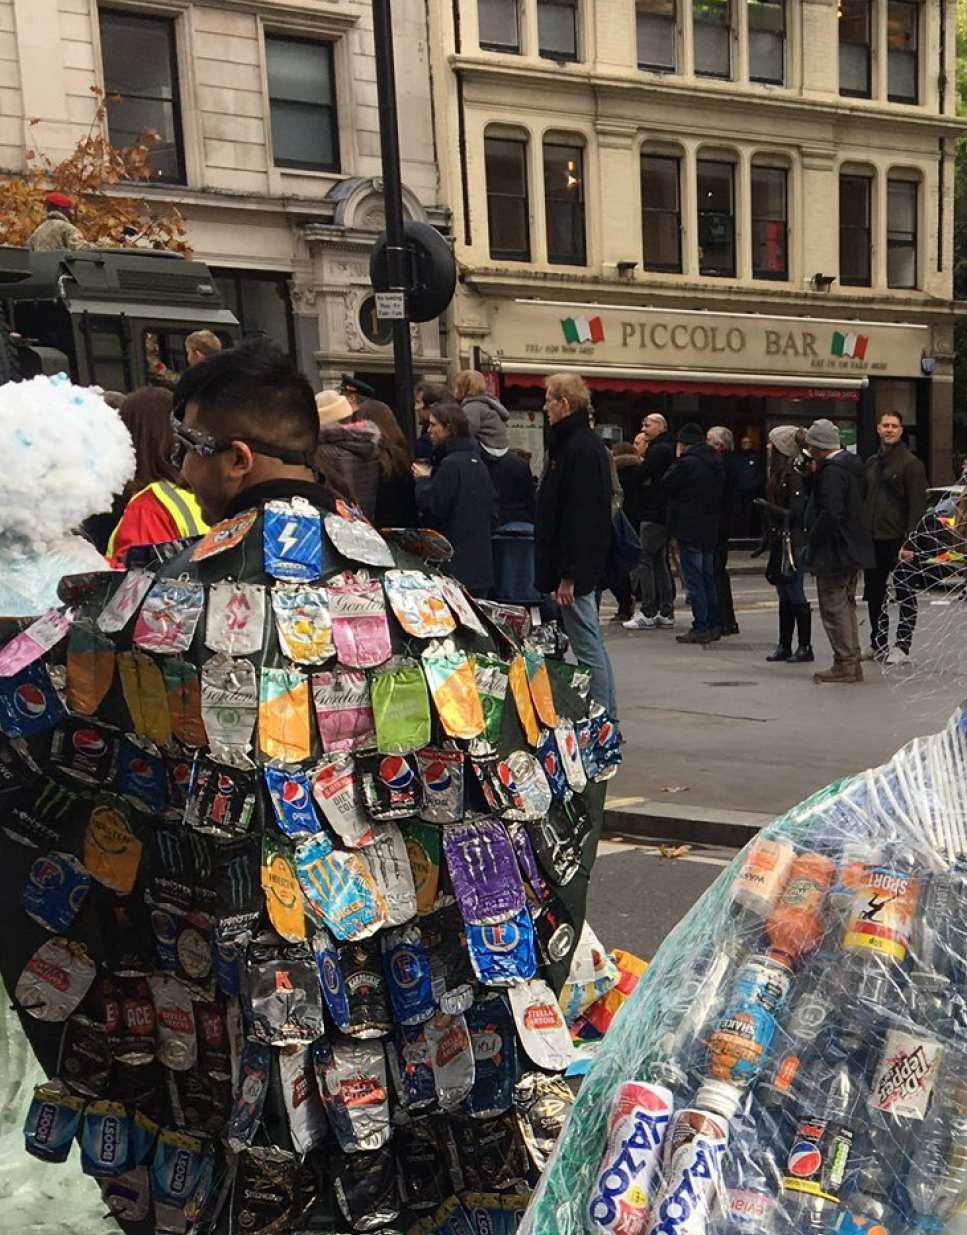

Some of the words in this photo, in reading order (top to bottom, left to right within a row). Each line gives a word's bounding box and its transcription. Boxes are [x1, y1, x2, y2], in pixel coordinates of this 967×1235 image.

[621, 321, 746, 352] PICCOLO
[764, 330, 818, 357] BAR
[864, 874, 909, 895] SPORT
[126, 1006, 151, 1028] ACE
[528, 1010, 554, 1020] STELLA
[879, 1046, 930, 1101] Pepper
[103, 1119, 116, 1160] BOOST
[172, 1150, 192, 1192] BOOST
[590, 1111, 669, 1226] YAZOO
